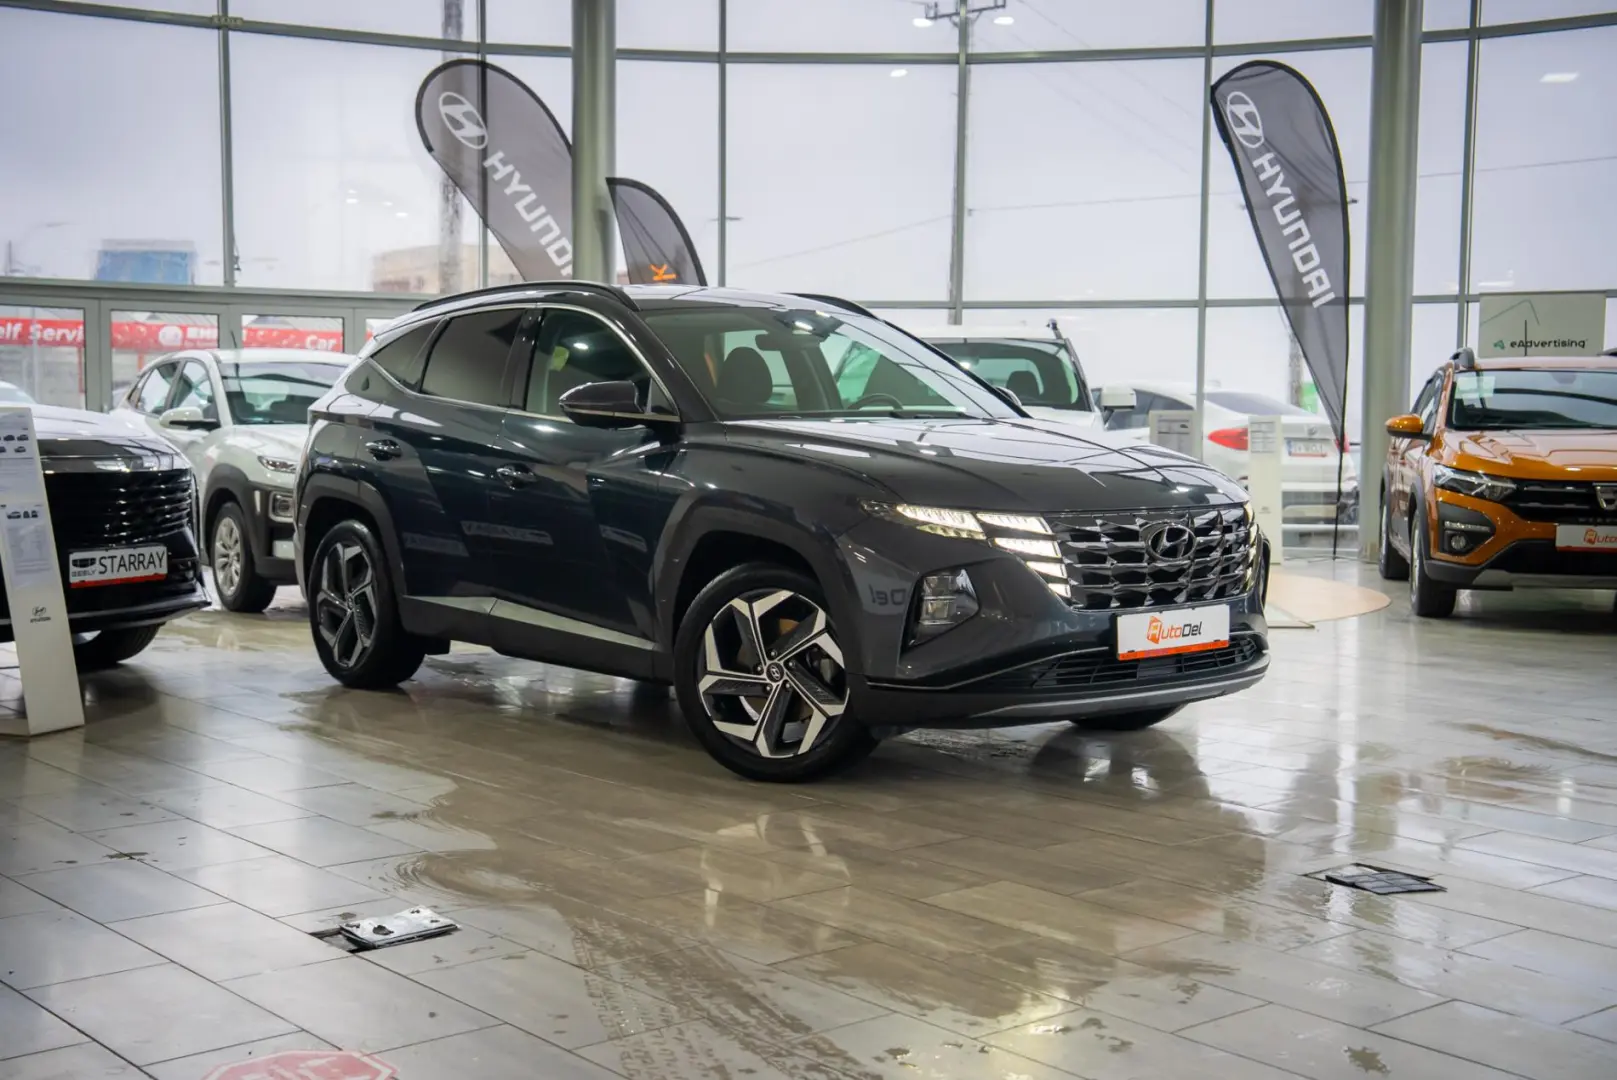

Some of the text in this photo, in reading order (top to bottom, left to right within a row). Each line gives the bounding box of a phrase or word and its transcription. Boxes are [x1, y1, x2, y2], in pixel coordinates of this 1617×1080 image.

[1252, 152, 1336, 309] HYUNDAI
[1509, 339, 1586, 349] eAdvertising
[99, 551, 165, 574] STARRAY
[1146, 616, 1203, 644] AutoDel
